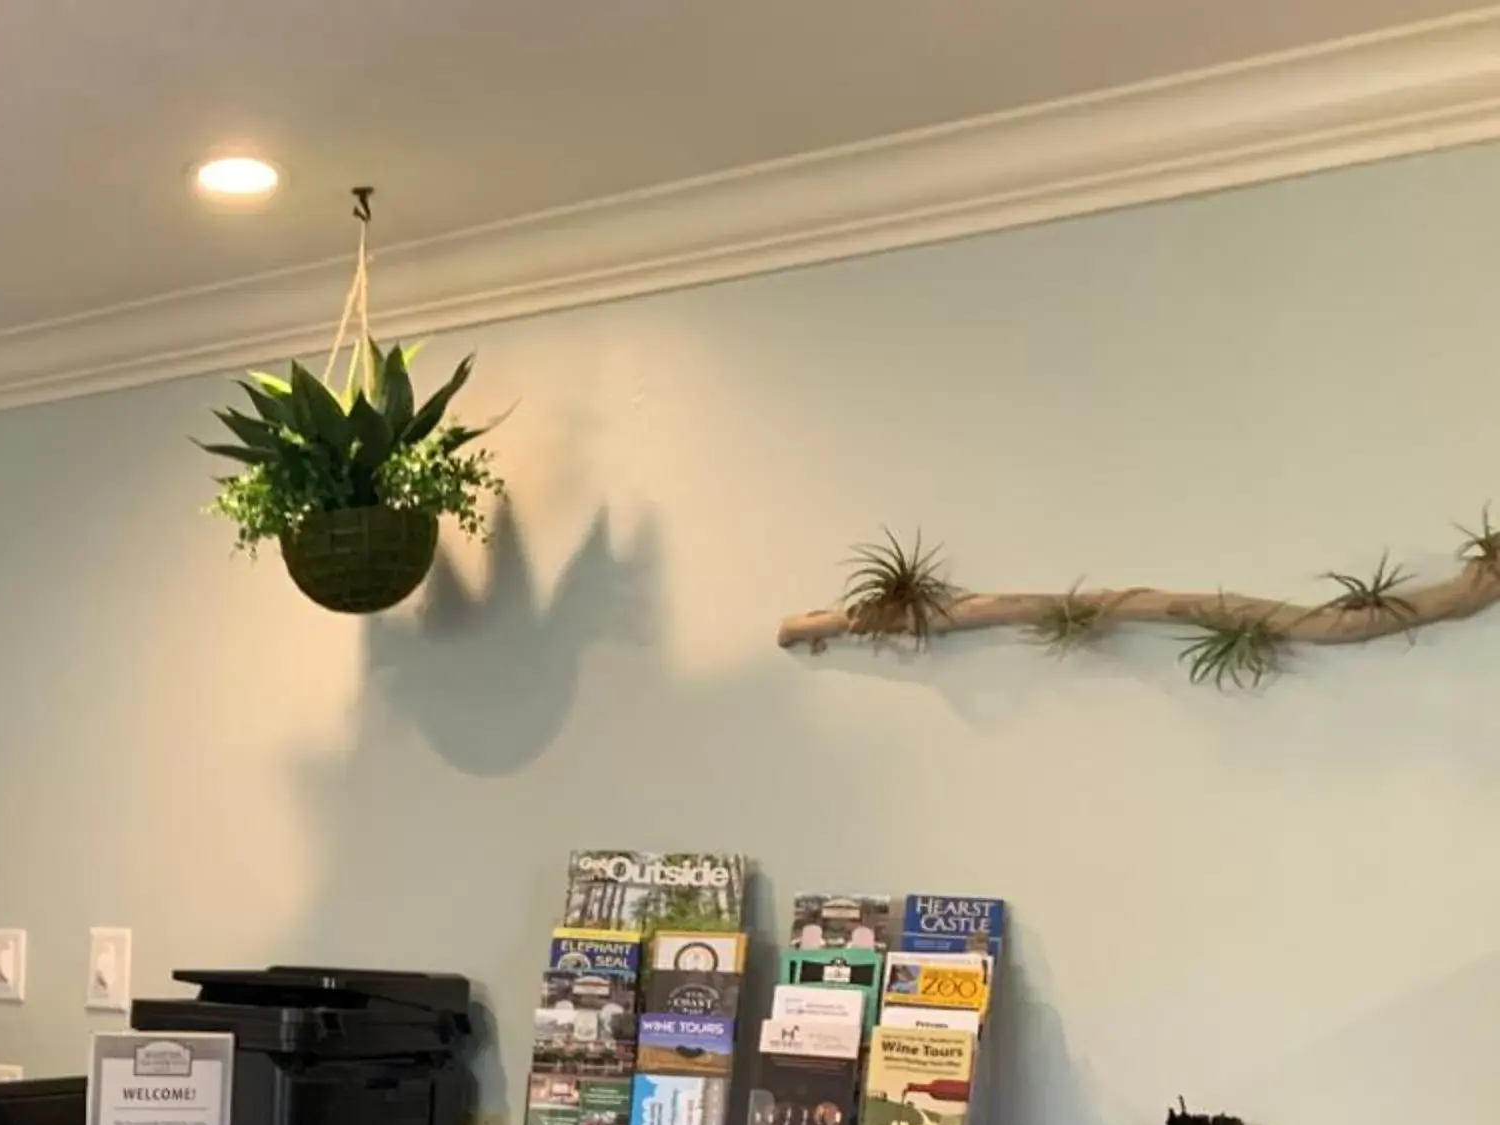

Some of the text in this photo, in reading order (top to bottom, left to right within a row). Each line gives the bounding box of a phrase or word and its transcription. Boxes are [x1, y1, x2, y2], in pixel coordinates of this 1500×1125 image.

[607, 855, 729, 886] Outside
[915, 896, 995, 917] HEARST
[920, 914, 991, 933] CASTLE
[560, 940, 632, 956] ELEPHANT
[595, 955, 629, 969] SEAL
[921, 974, 978, 999] ZOO
[642, 1021, 725, 1036] WINE TOURS
[881, 1041, 963, 1058] Wine Tours
[123, 1086, 197, 1101] WELCOME!
